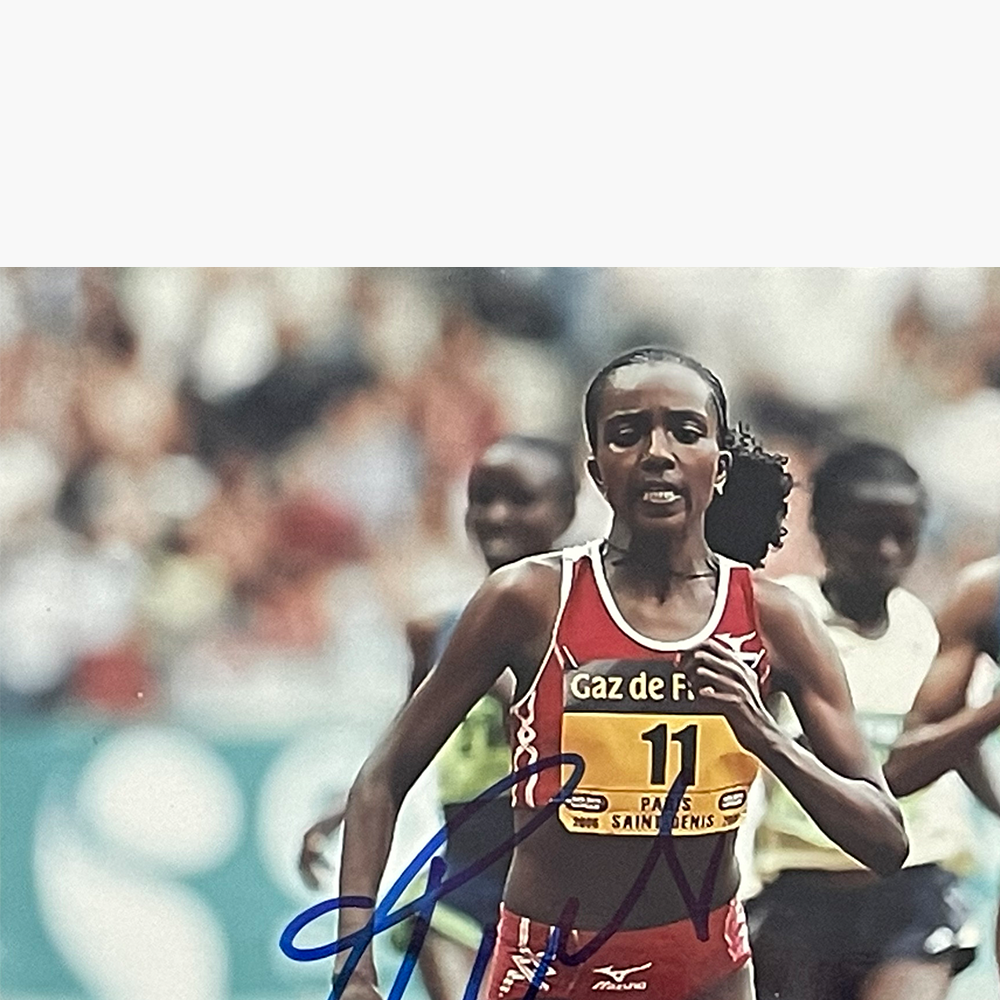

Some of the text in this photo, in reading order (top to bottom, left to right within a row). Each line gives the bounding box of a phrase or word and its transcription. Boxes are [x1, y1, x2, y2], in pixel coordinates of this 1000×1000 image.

[570, 672, 624, 700] Gaz
[628, 671, 665, 701] de
[641, 723, 698, 787] 11
